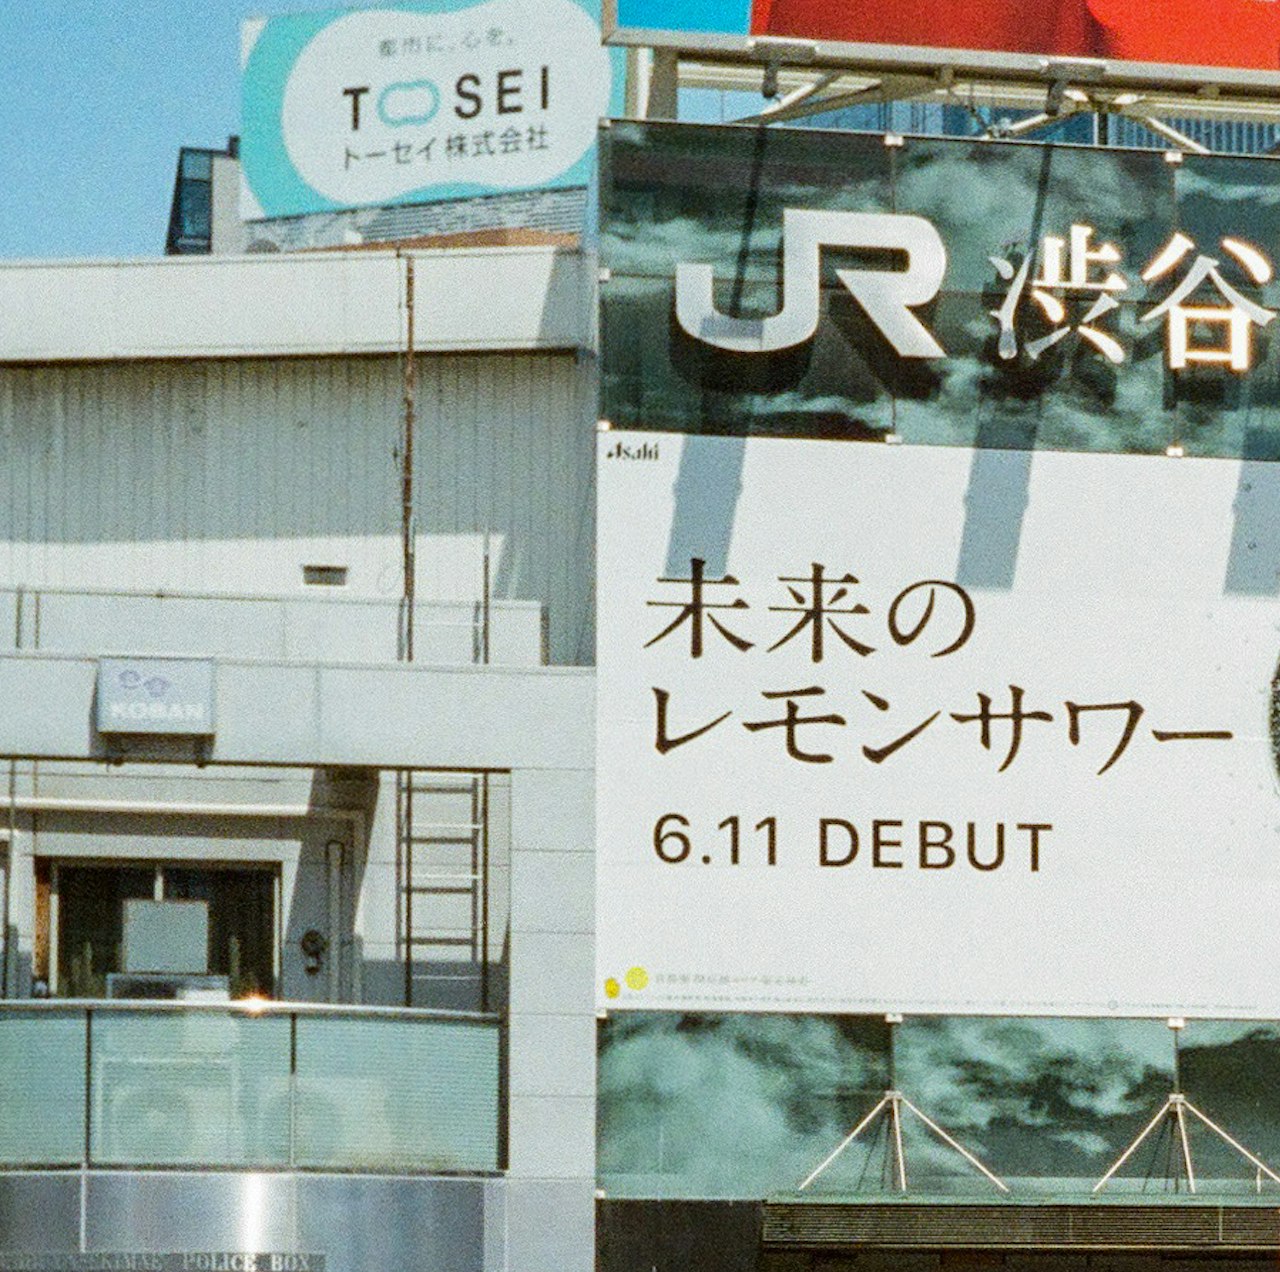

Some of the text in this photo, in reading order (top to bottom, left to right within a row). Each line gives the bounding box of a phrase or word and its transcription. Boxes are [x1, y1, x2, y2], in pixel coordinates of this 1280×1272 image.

[342, 64, 549, 131] TOSEI
[344, 123, 550, 171] トーセイ株式会社
[675, 208, 947, 358] JR
[643, 557, 976, 664] 未来の
[650, 685, 1233, 776] レモンサワー
[652, 813, 1053, 873] 6.11 DEBUT
[182, 1252, 259, 1272] POLICE
[270, 1251, 312, 1272] BOX
